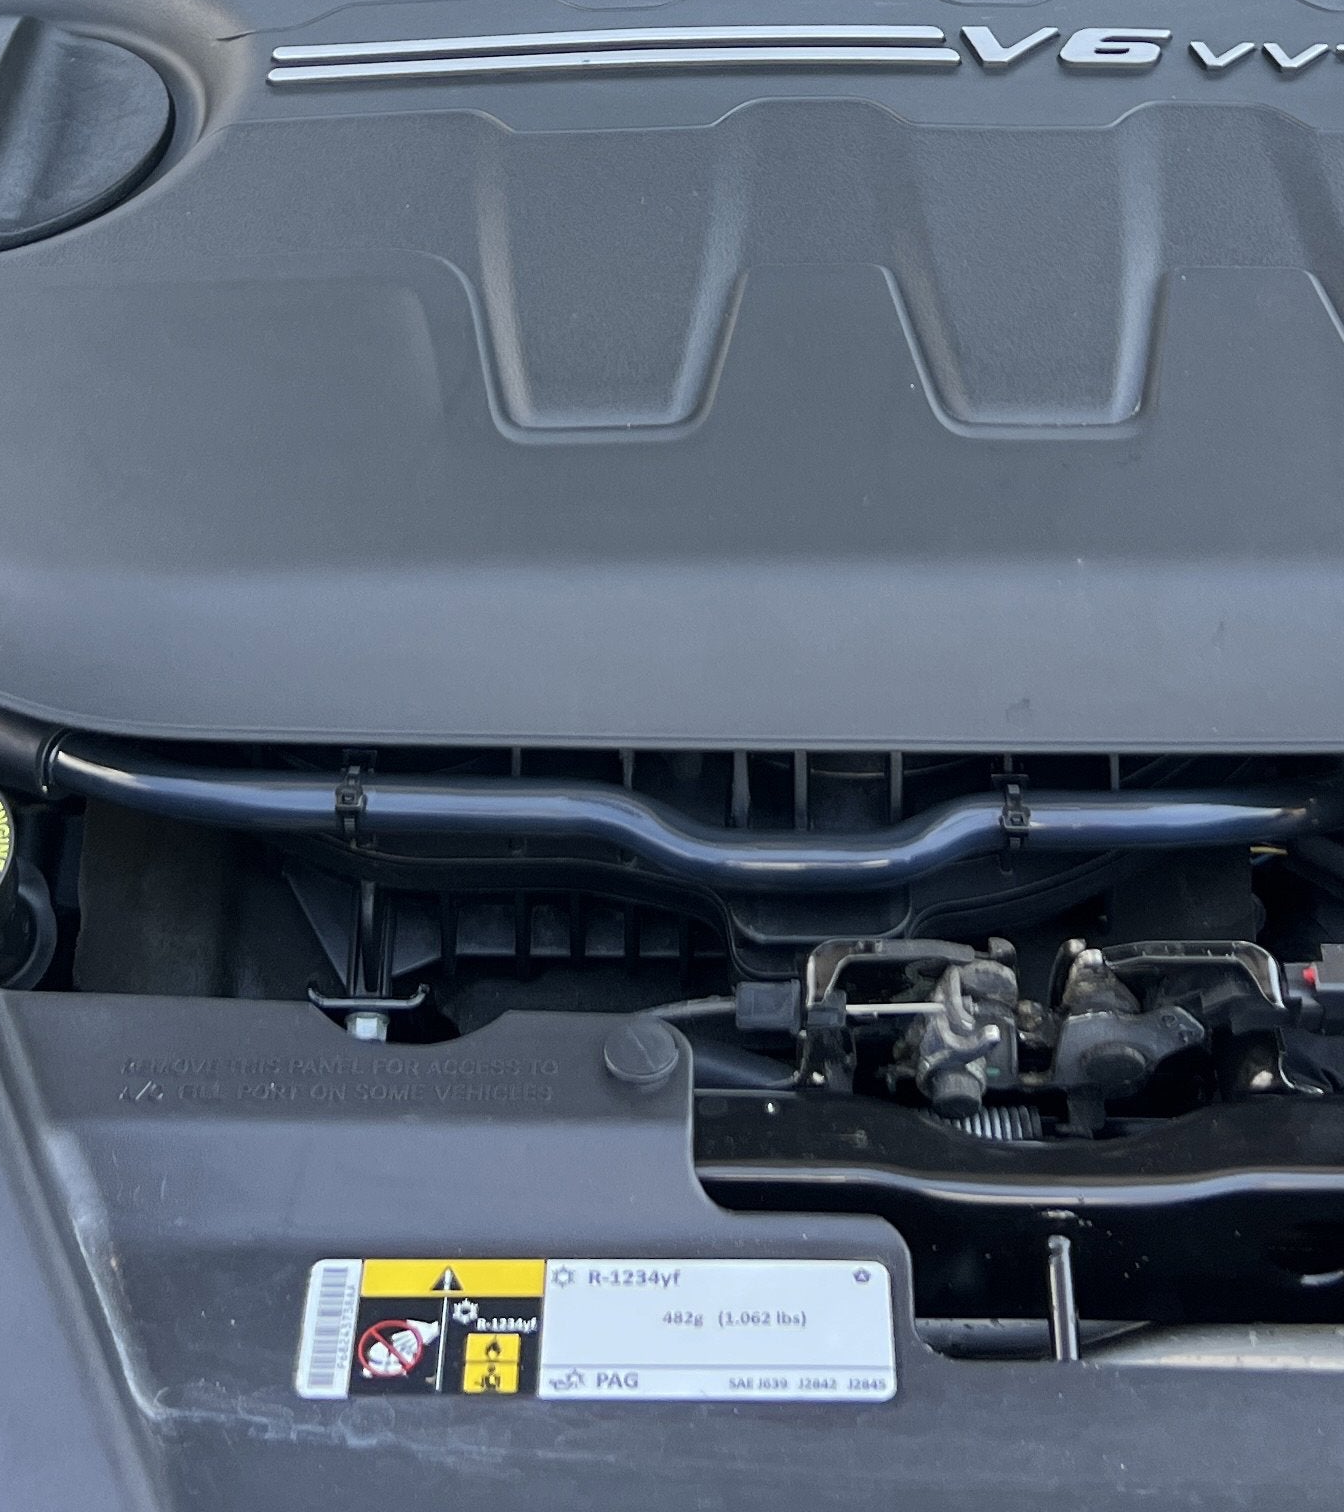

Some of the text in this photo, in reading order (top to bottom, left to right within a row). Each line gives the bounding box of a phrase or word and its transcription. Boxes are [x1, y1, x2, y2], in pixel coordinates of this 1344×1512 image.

[960, 26, 1173, 67] V6
[289, 1058, 362, 1074] PANEL
[373, 1059, 420, 1075] FOR
[427, 1058, 522, 1075] ACCESS
[528, 1059, 560, 1075] TO
[309, 1083, 346, 1100] ON
[355, 1083, 426, 1100] SOME
[433, 1083, 553, 1101] VEHICLES
[588, 1269, 681, 1288] R-1234yf
[476, 1317, 537, 1333] R-1234yf
[662, 1310, 807, 1327] 482g (1.062 lbs)
[596, 1372, 639, 1388] PAG
[729, 1379, 753, 1389] SAE
